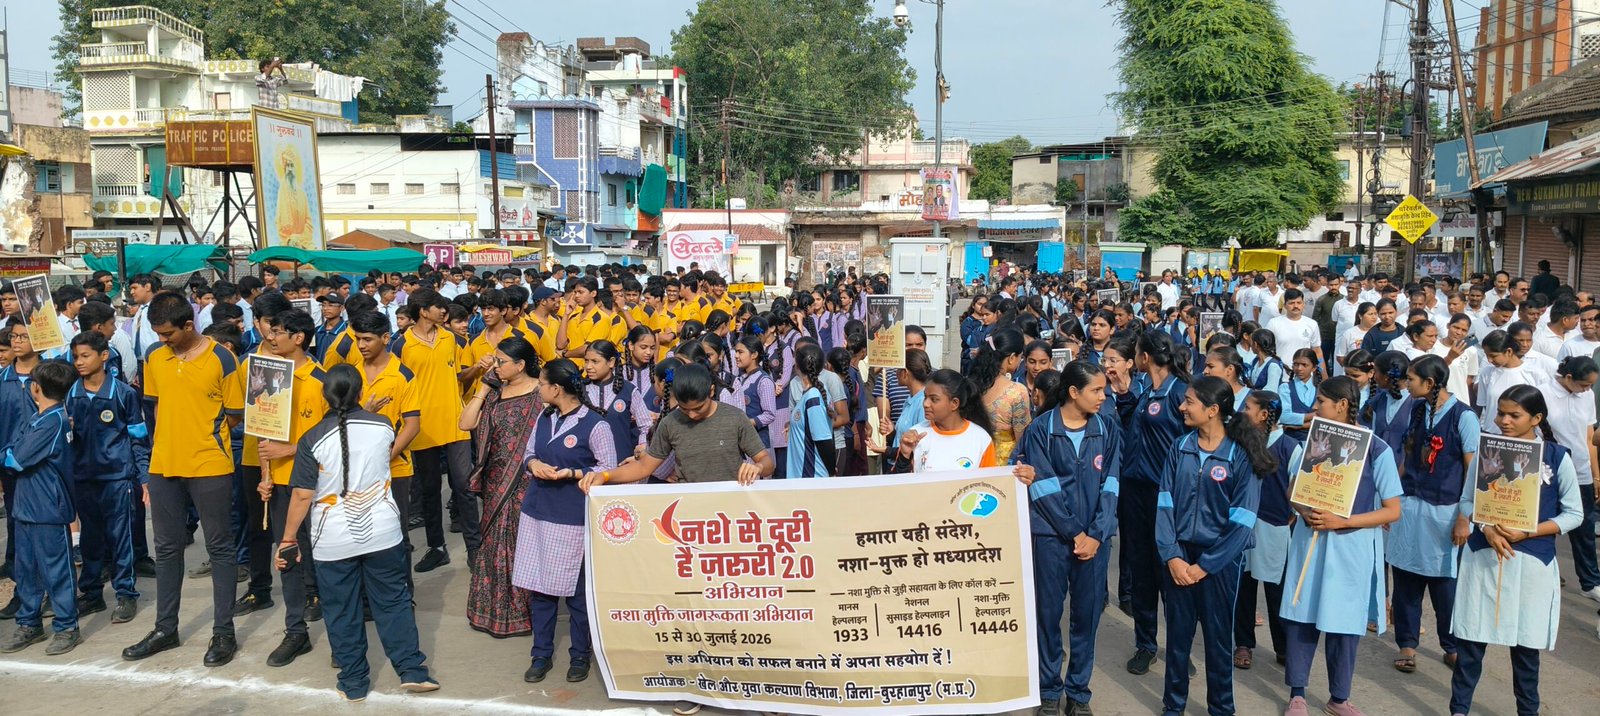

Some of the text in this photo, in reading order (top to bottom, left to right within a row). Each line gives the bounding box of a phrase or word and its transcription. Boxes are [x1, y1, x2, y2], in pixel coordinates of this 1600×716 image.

[169, 129, 253, 143] TRAFFIC POLICE
[1516, 188, 1531, 202] NEW
[1534, 184, 1572, 201] SUKHWANI
[440, 249, 449, 259] P
[672, 236, 723, 256] येवले
[1345, 429, 1362, 437] DRUGS
[679, 510, 811, 552] नशे से दूरी
[856, 519, 980, 548] हमारा यही संदेश,
[675, 547, 693, 578] है
[782, 555, 814, 579] 2.0
[838, 543, 1001, 574] नशा-मुक्त हो मध्यप्रदेश
[705, 582, 783, 600] अभियान
[864, 586, 881, 598] मुक्ति
[884, 585, 890, 594] से
[892, 584, 906, 596] जुड़ी
[909, 583, 936, 593] सहायता
[939, 581, 946, 590] के
[948, 580, 963, 590] लिए
[965, 578, 982, 588] कॉल
[984, 577, 996, 587] करें
[904, 598, 929, 606] नेशनल
[974, 592, 1010, 603] नशा-मुक्ति
[610, 604, 813, 626] नशा मुक्ति जागरूकता अभियान
[832, 613, 867, 626] हेल्पलाइन
[886, 609, 950, 624] सुसाइड हेल्पलाइन
[975, 606, 1011, 617] हेल्पलाइन
[834, 628, 868, 642] 1933
[896, 623, 942, 638] 14416
[970, 619, 1018, 635] 14446
[655, 628, 772, 646] 15 से 30 जुलाई 2026
[665, 654, 683, 664] इस
[688, 650, 733, 666] अभियान
[738, 653, 754, 667] को
[758, 657, 791, 669] सफल
[795, 654, 826, 669] बनाने
[831, 653, 842, 669] में
[846, 656, 881, 668] अपना
[885, 649, 928, 666] सहयोग
[932, 648, 942, 666] दें
[644, 673, 686, 688] आयोजक
[698, 674, 717, 690] खेल
[719, 678, 739, 693] और
[742, 682, 761, 697] युवा
[764, 683, 802, 697] कल्याण
[805, 682, 842, 701] विभाग,
[936, 680, 975, 698] (म.प्र.)
